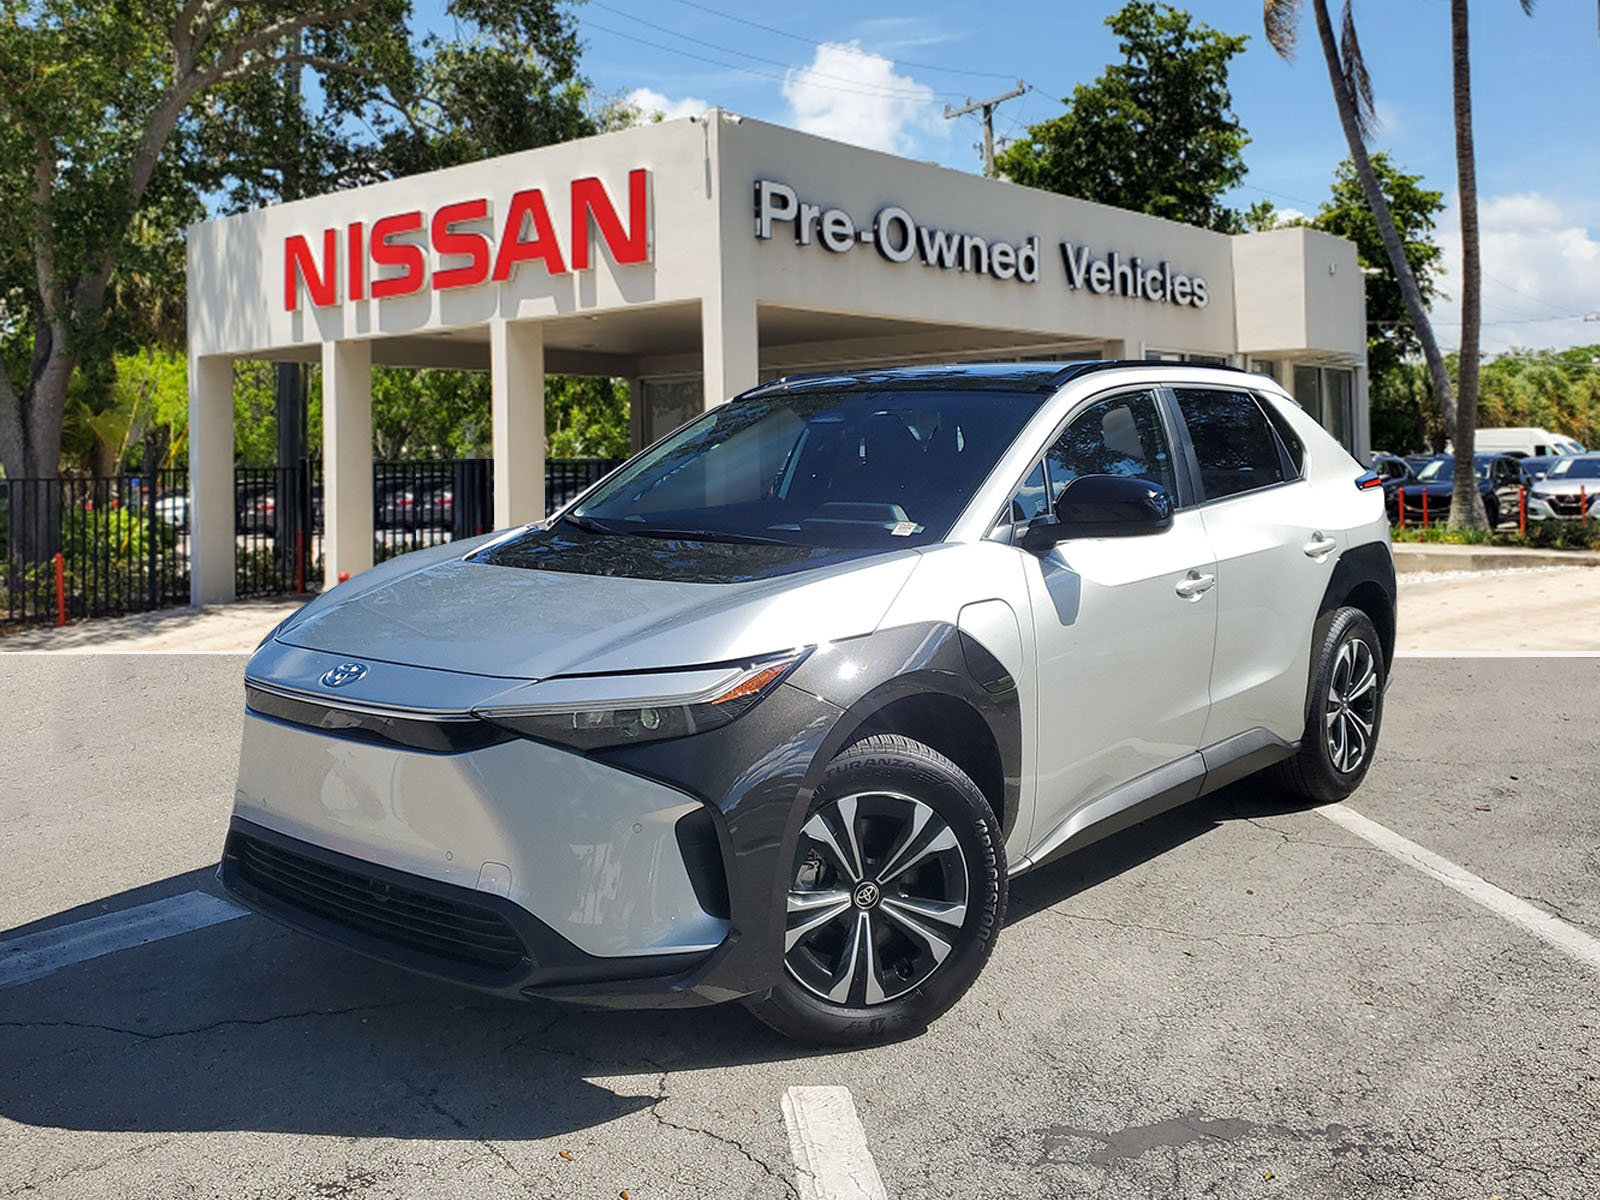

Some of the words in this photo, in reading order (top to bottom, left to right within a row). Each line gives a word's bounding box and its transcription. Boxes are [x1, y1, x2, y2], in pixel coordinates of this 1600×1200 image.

[285, 168, 649, 312] NISSAN
[755, 180, 1040, 283] Pre-Owned
[1060, 242, 1208, 308] Vehicles
